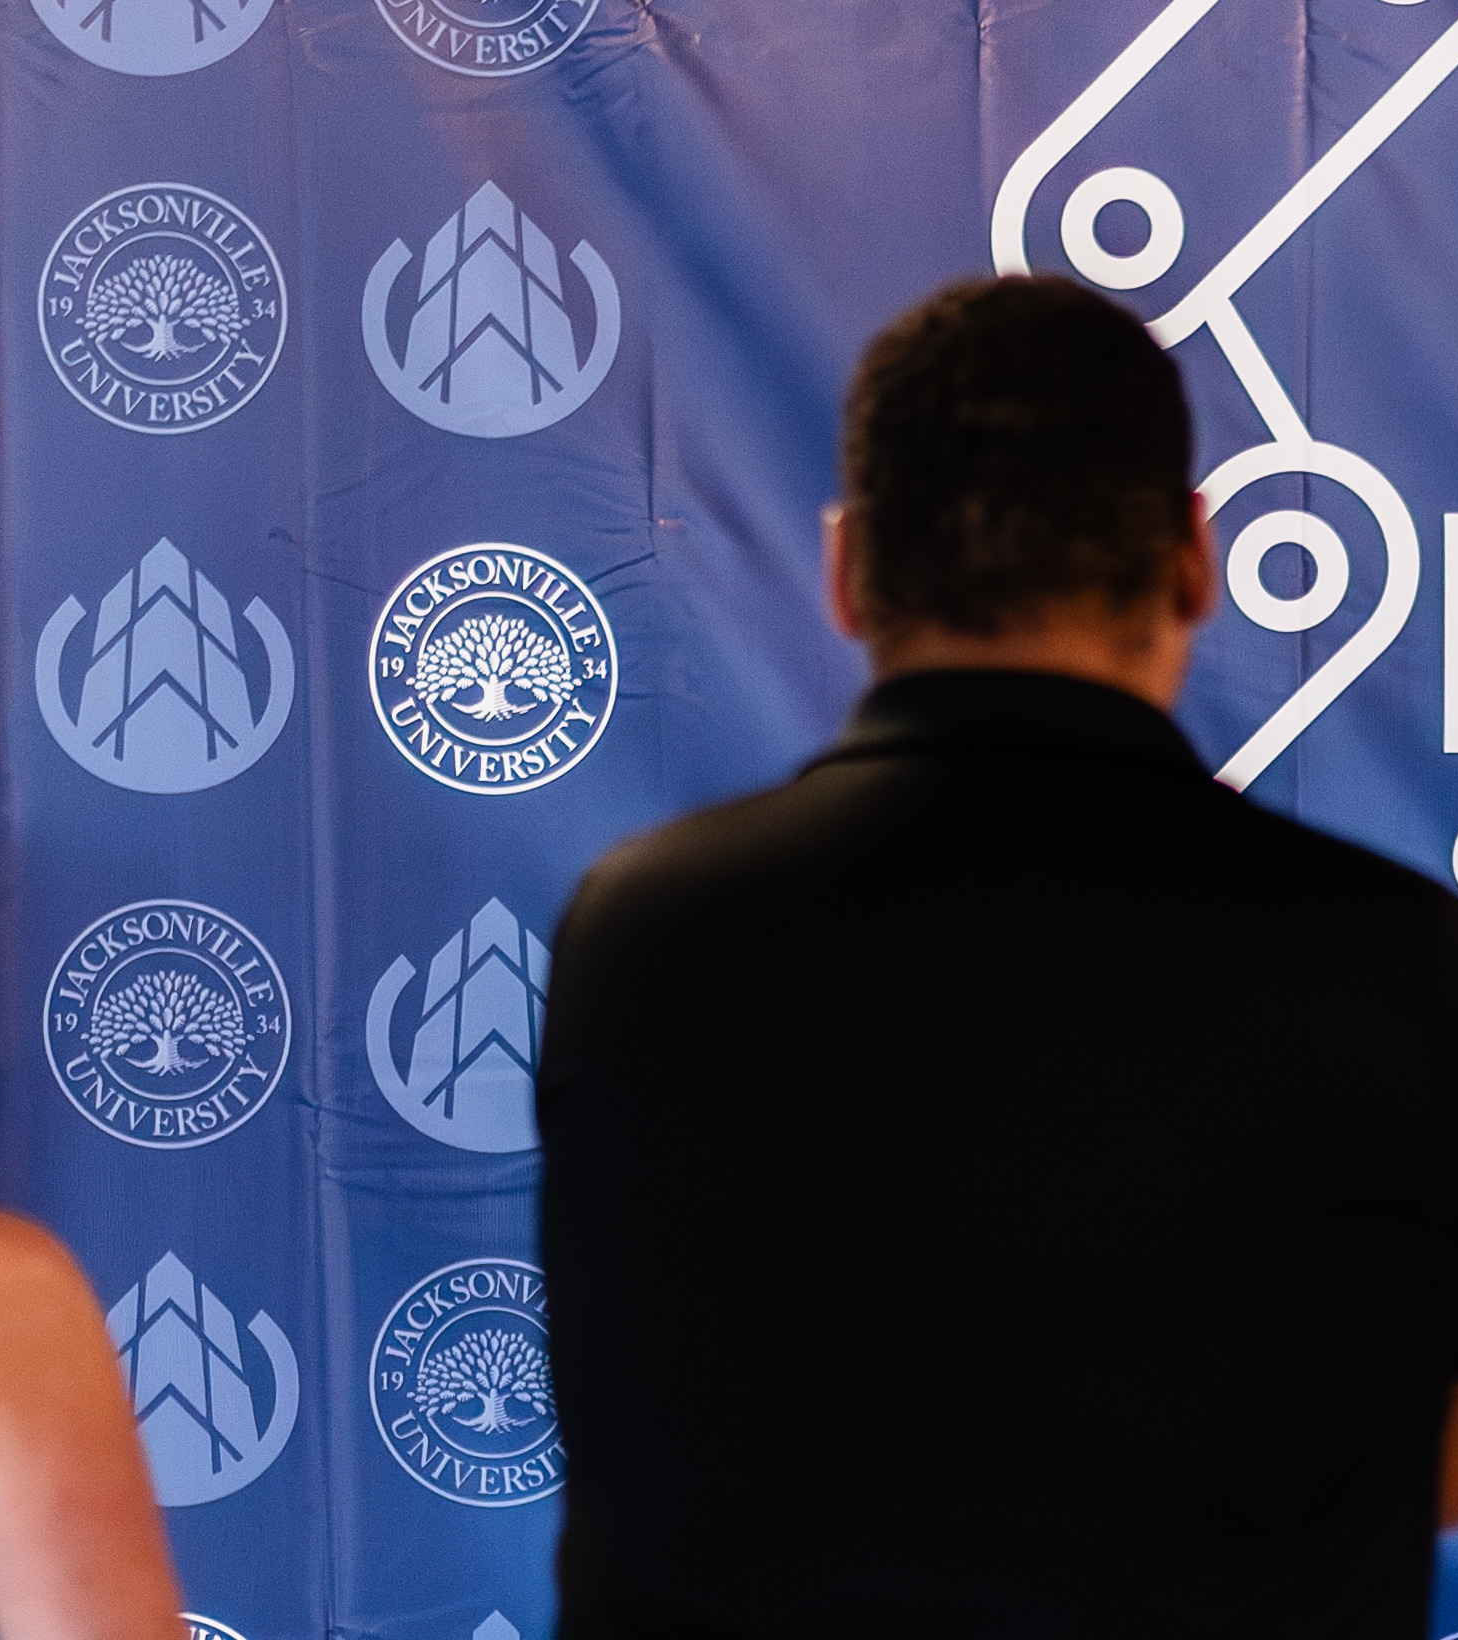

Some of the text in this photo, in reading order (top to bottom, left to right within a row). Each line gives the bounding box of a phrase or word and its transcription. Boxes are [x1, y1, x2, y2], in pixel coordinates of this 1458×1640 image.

[392, 0, 587, 64] NIVERSIT
[53, 194, 271, 292] JACKSONVILLE
[48, 296, 276, 319] 19 34
[60, 338, 266, 423] UNIVERSITY
[384, 555, 601, 653] JACKSONVILLE
[380, 657, 607, 680] 19 34
[391, 697, 597, 783] UNIVERSITY
[59, 911, 274, 1008] JACKSONVILLE
[54, 1012, 281, 1035] 19 34
[65, 1052, 270, 1137] UNIVERSITY
[386, 1270, 550, 1367] JACKSONV
[380, 1371, 404, 1391] 19
